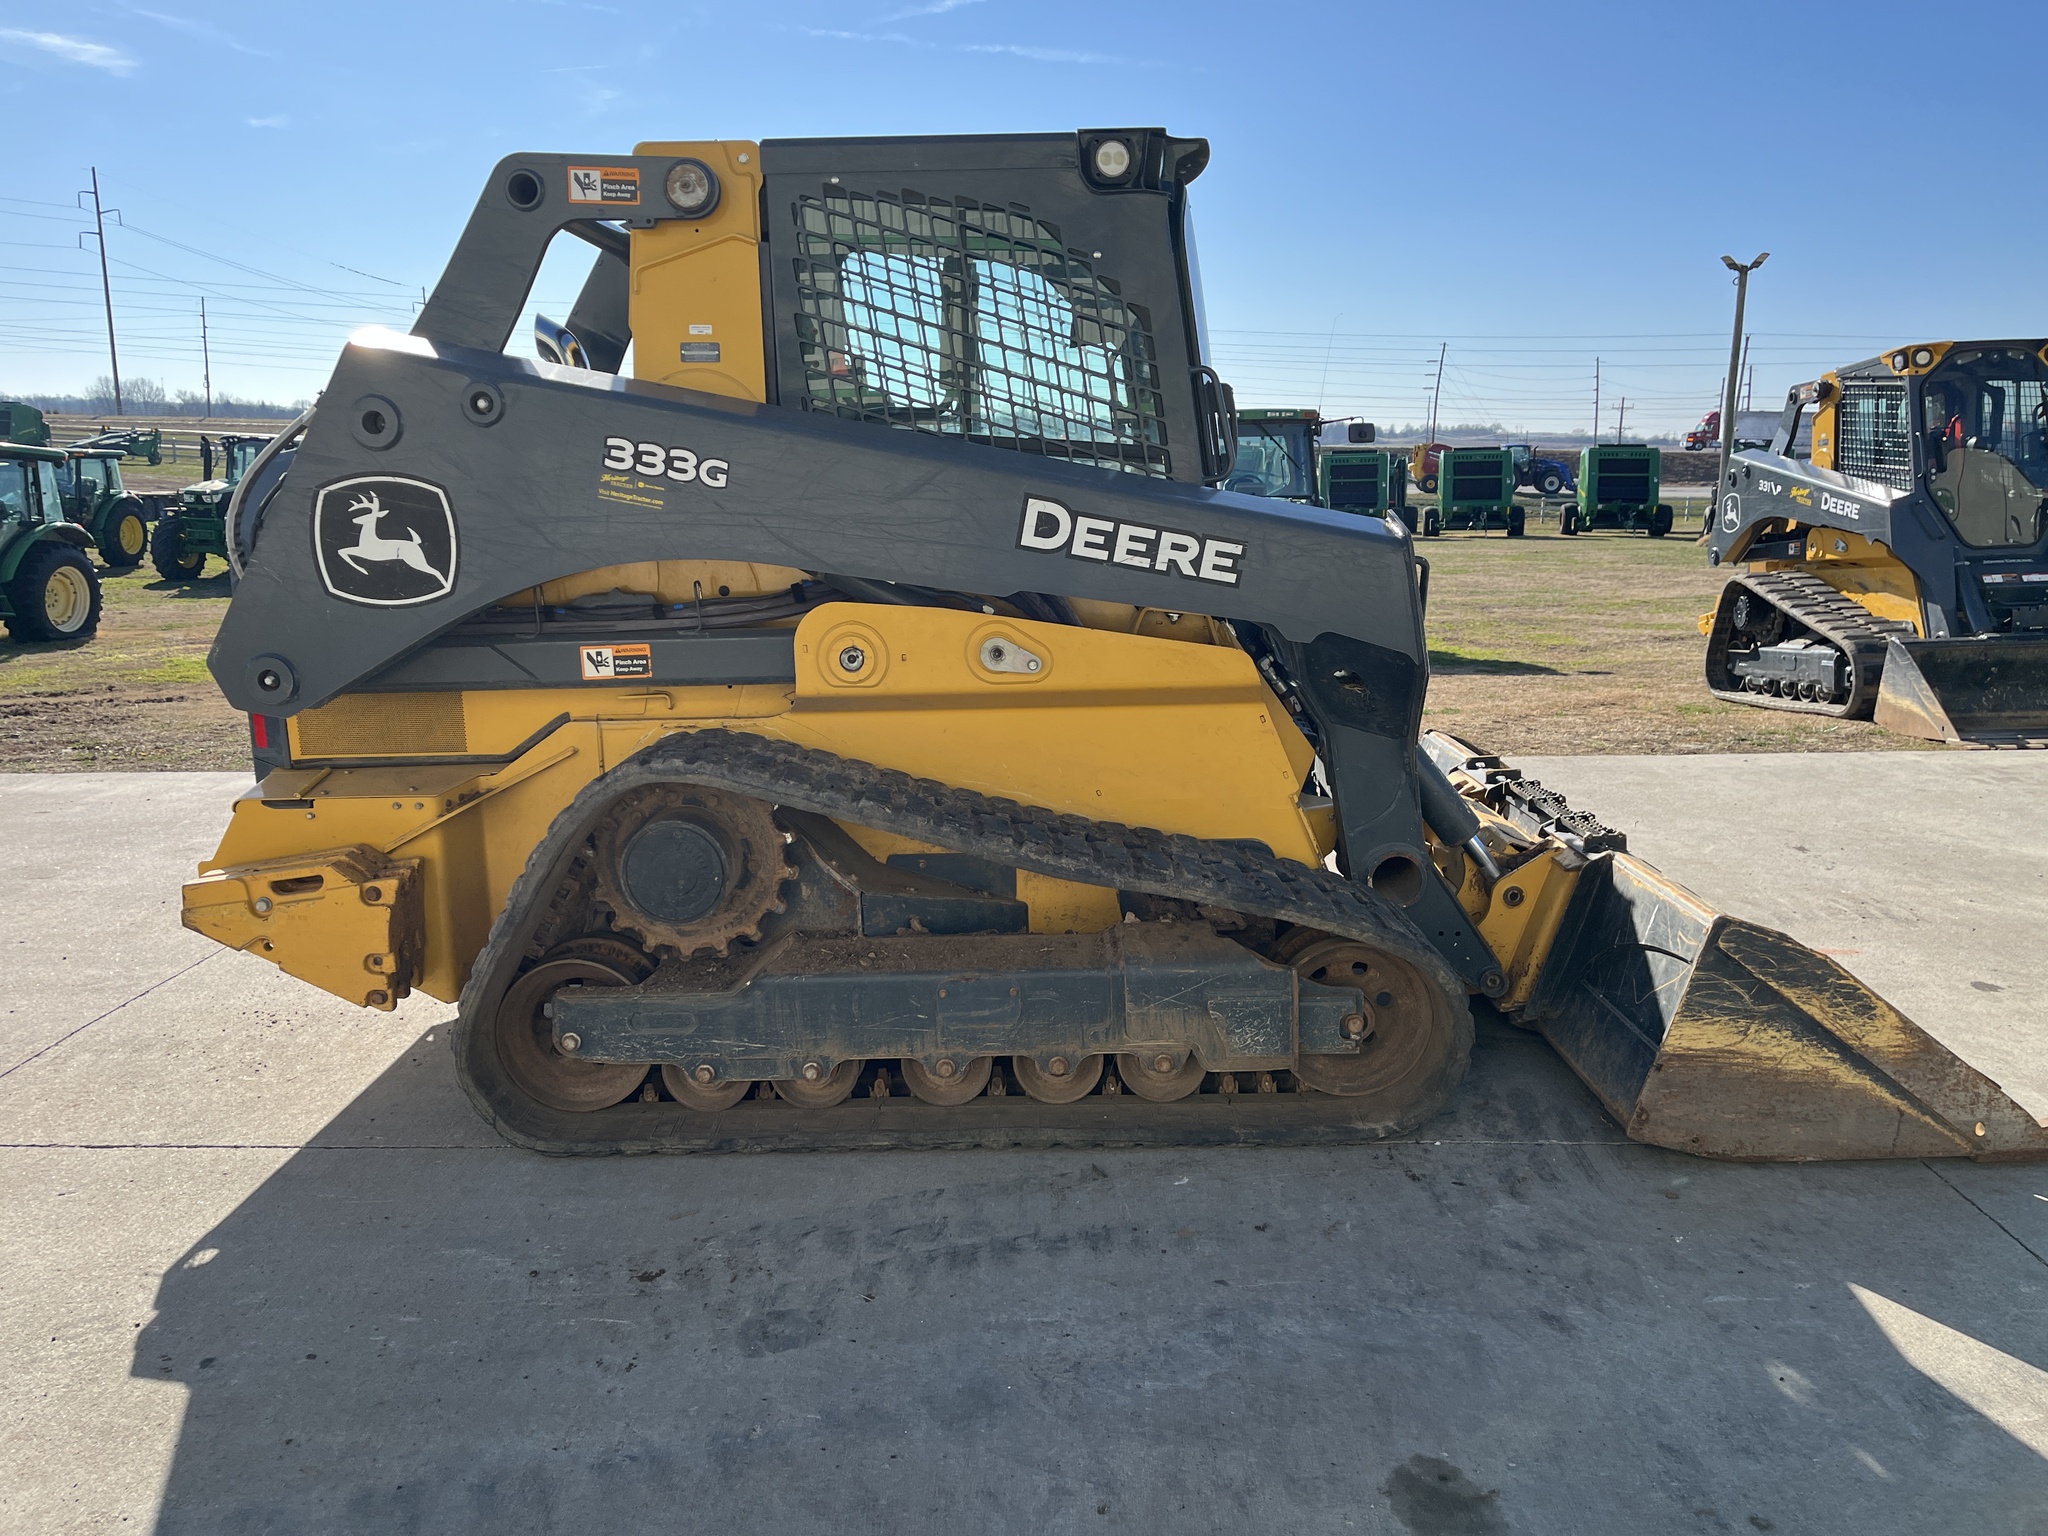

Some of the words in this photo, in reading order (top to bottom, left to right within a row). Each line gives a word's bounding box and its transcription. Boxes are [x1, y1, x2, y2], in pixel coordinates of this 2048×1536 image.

[604, 437, 729, 488] 333G
[1820, 491, 1861, 520] DEERE
[1020, 497, 1244, 585] DEERE
